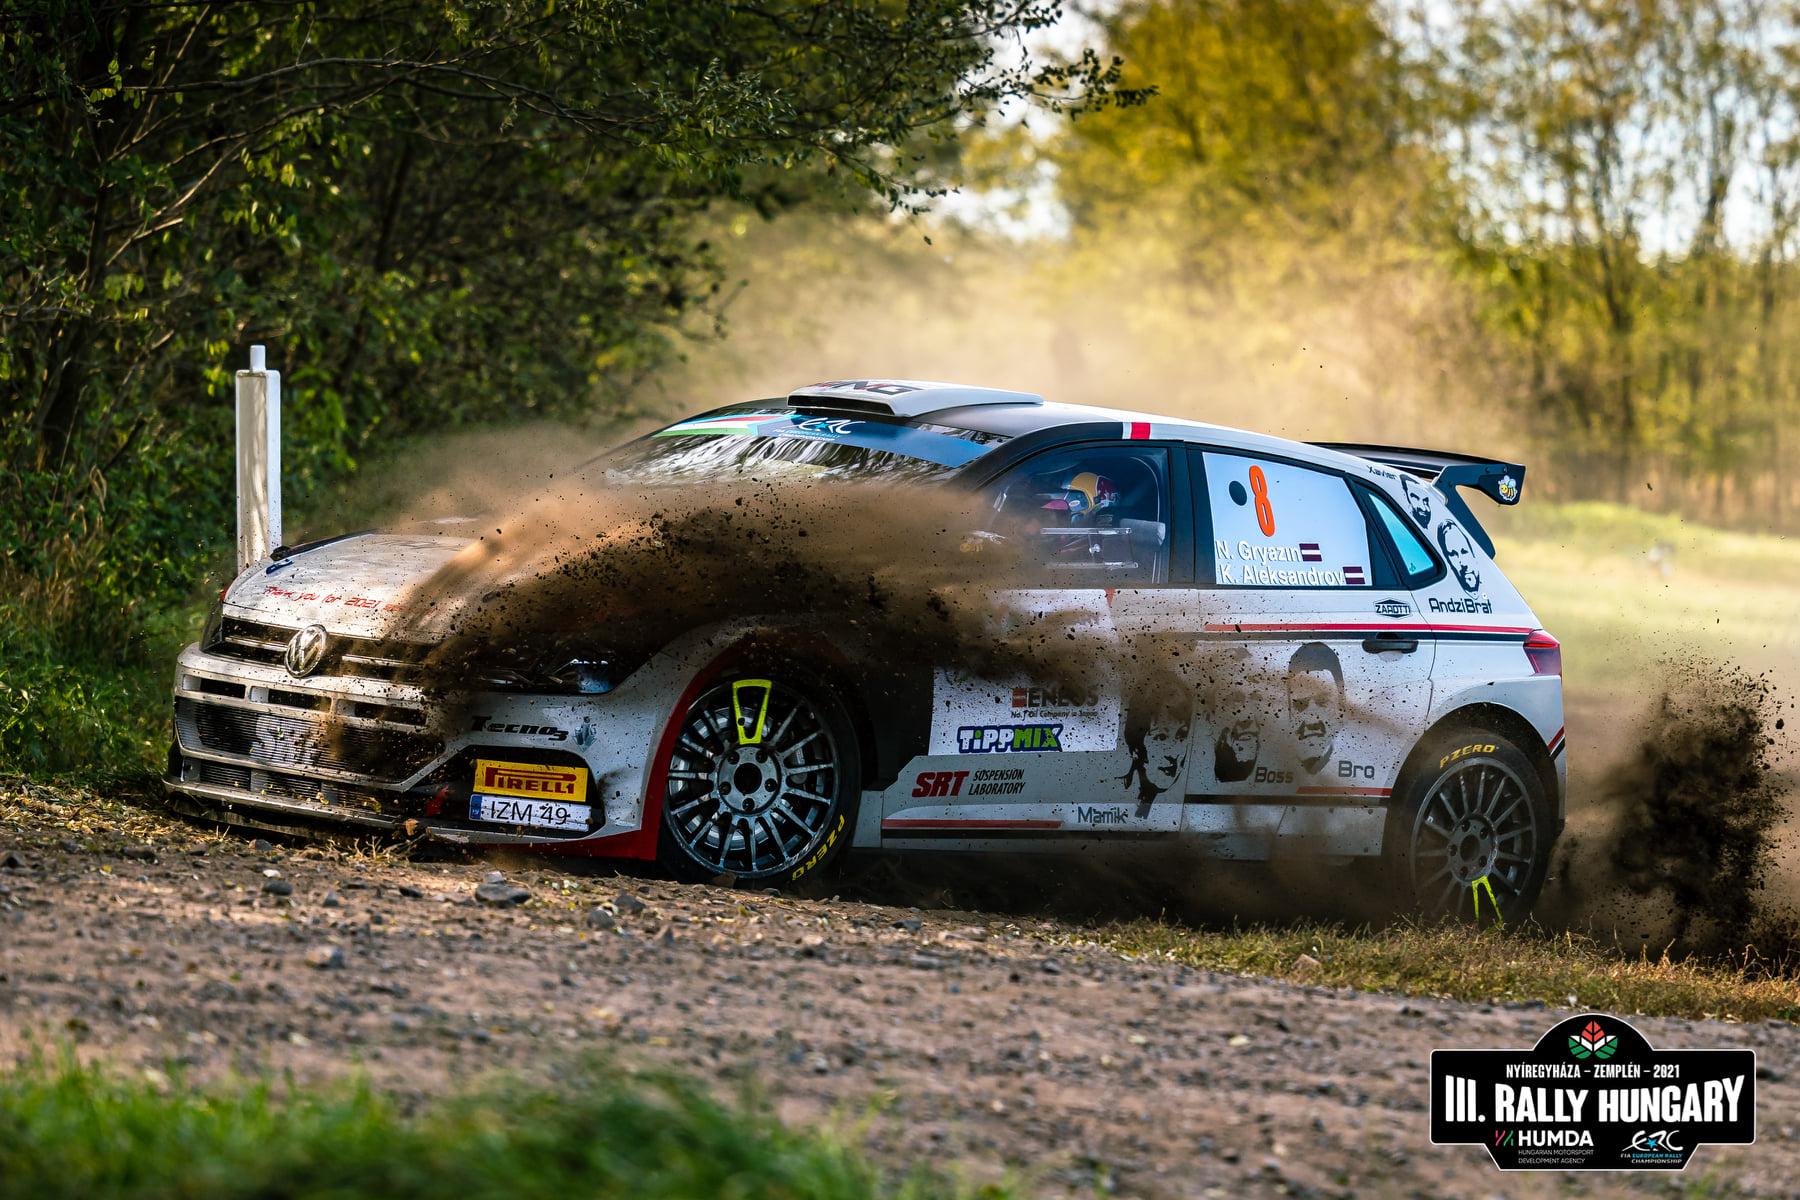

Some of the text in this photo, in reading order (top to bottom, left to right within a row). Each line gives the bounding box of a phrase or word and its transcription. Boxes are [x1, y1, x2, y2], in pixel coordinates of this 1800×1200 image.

[1248, 465, 1275, 537] 8
[1215, 540, 1303, 565] N. Gryazin
[1219, 564, 1343, 585] K. Aleksandrov
[263, 586, 294, 598] Thank
[294, 592, 320, 602] you
[321, 594, 342, 604] for
[344, 597, 381, 609] 2021
[1428, 597, 1492, 614] AndziBrat
[484, 766, 577, 794] PIRELLI
[973, 769, 1025, 781] SUSPENSION
[1254, 766, 1295, 783] Boss
[1338, 760, 1375, 779] Bro
[911, 770, 970, 797] SRT
[968, 782, 1026, 795] LABORATORY
[490, 801, 568, 825] IZM 49
[1077, 807, 1127, 824] Mamik
